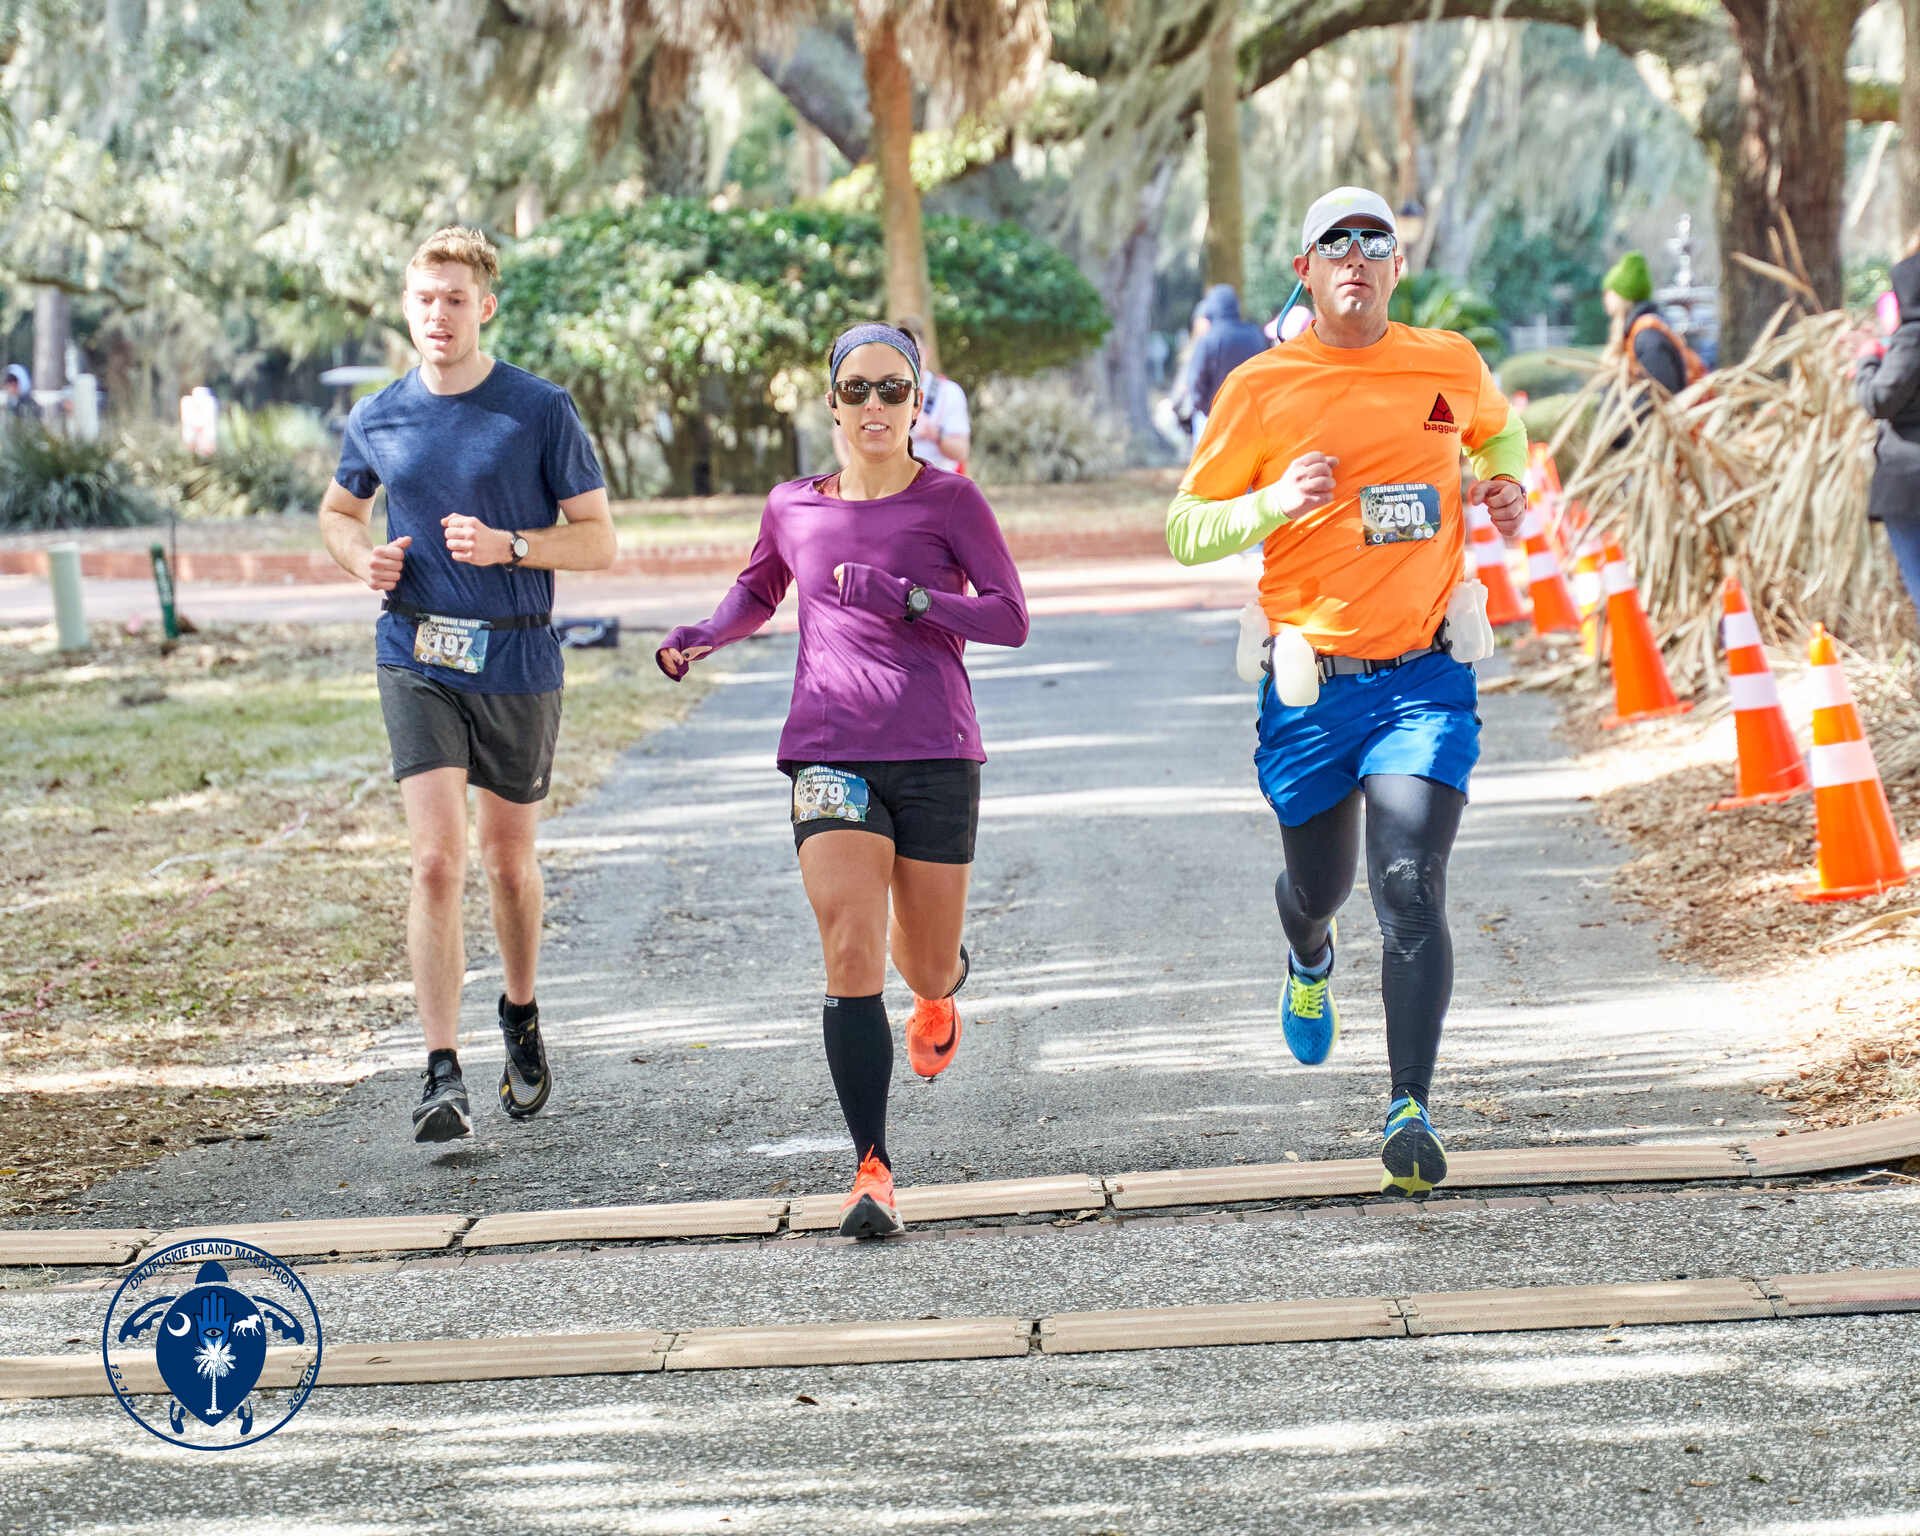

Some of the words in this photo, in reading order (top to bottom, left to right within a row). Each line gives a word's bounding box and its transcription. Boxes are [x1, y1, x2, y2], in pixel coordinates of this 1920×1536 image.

[1379, 501, 1426, 528] 290
[431, 633, 473, 657] 197
[813, 783, 844, 805] 79
